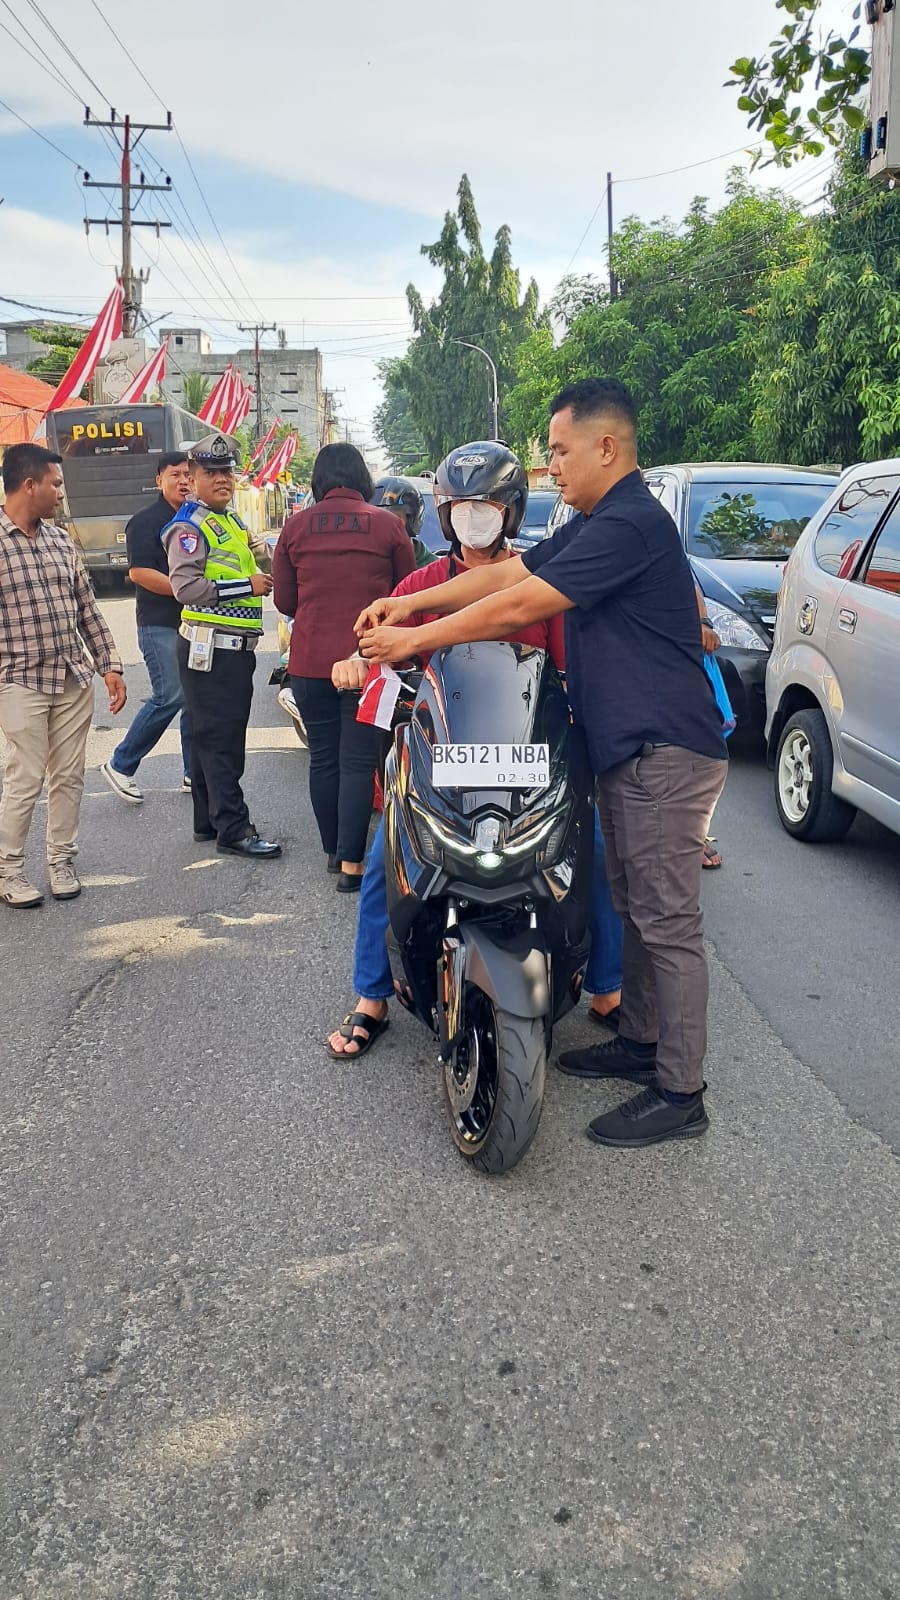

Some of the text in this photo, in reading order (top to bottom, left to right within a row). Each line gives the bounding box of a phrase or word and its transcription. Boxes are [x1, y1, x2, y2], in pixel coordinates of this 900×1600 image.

[72, 421, 144, 441] POLISI
[318, 512, 361, 531] PPA
[511, 745, 548, 764] NBA
